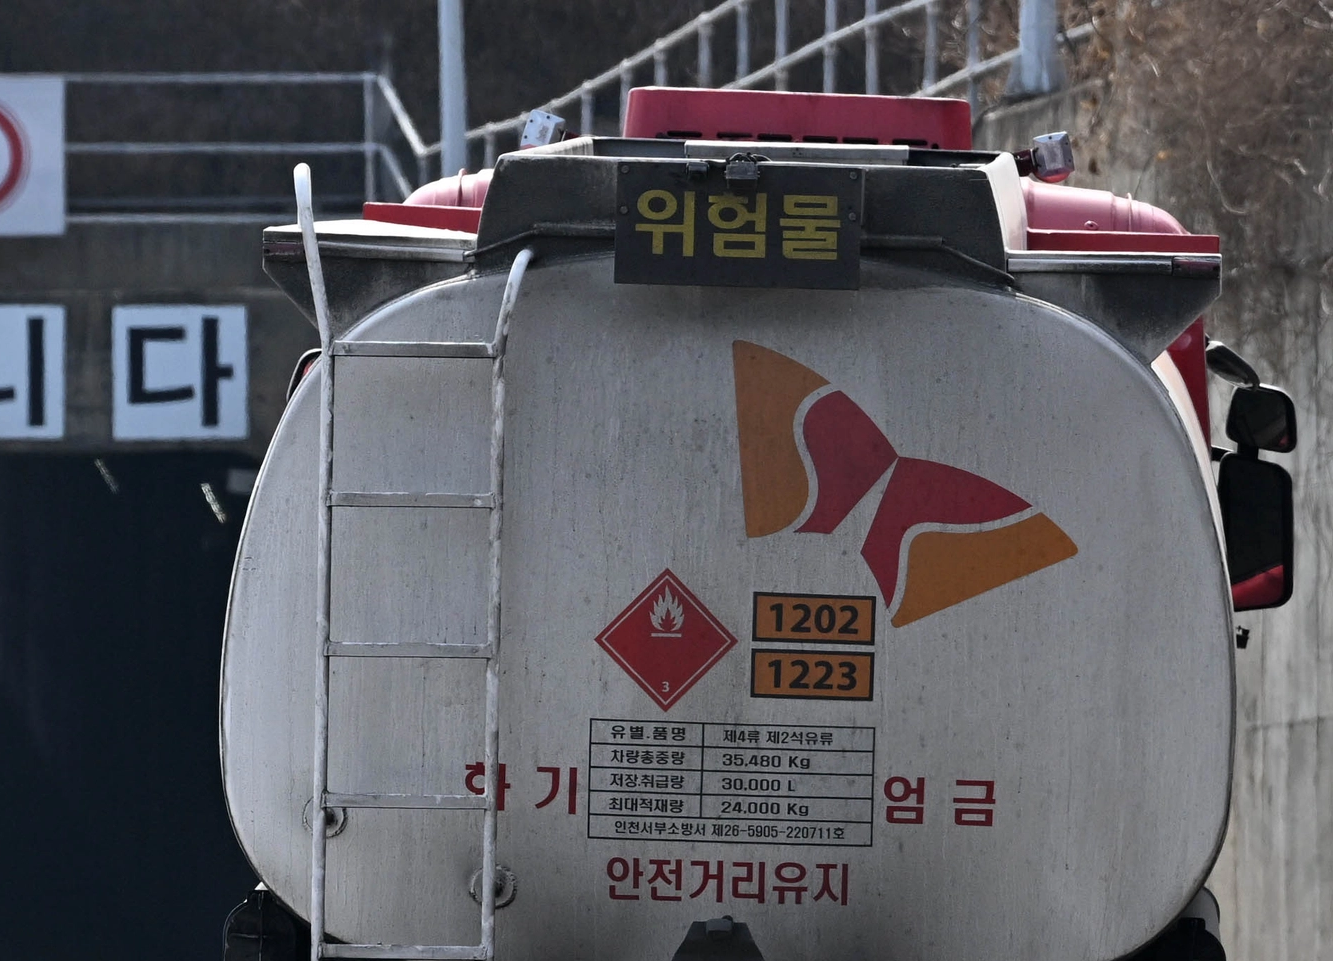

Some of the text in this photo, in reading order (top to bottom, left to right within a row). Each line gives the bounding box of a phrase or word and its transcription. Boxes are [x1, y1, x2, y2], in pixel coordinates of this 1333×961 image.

[635, 189, 841, 260] 위험물
[769, 603, 859, 635] 1202
[768, 659, 857, 691] 1223
[661, 681, 670, 693] 3
[723, 729, 833, 746] 제4류 제2석유류
[611, 749, 685, 765] 차량총중량
[788, 755, 811, 769] Kg
[787, 780, 795, 792] L
[609, 797, 684, 813] 최대적재량
[787, 803, 809, 816] Kg
[614, 820, 844, 840] 인천서부소방서 제26-5905-220711호
